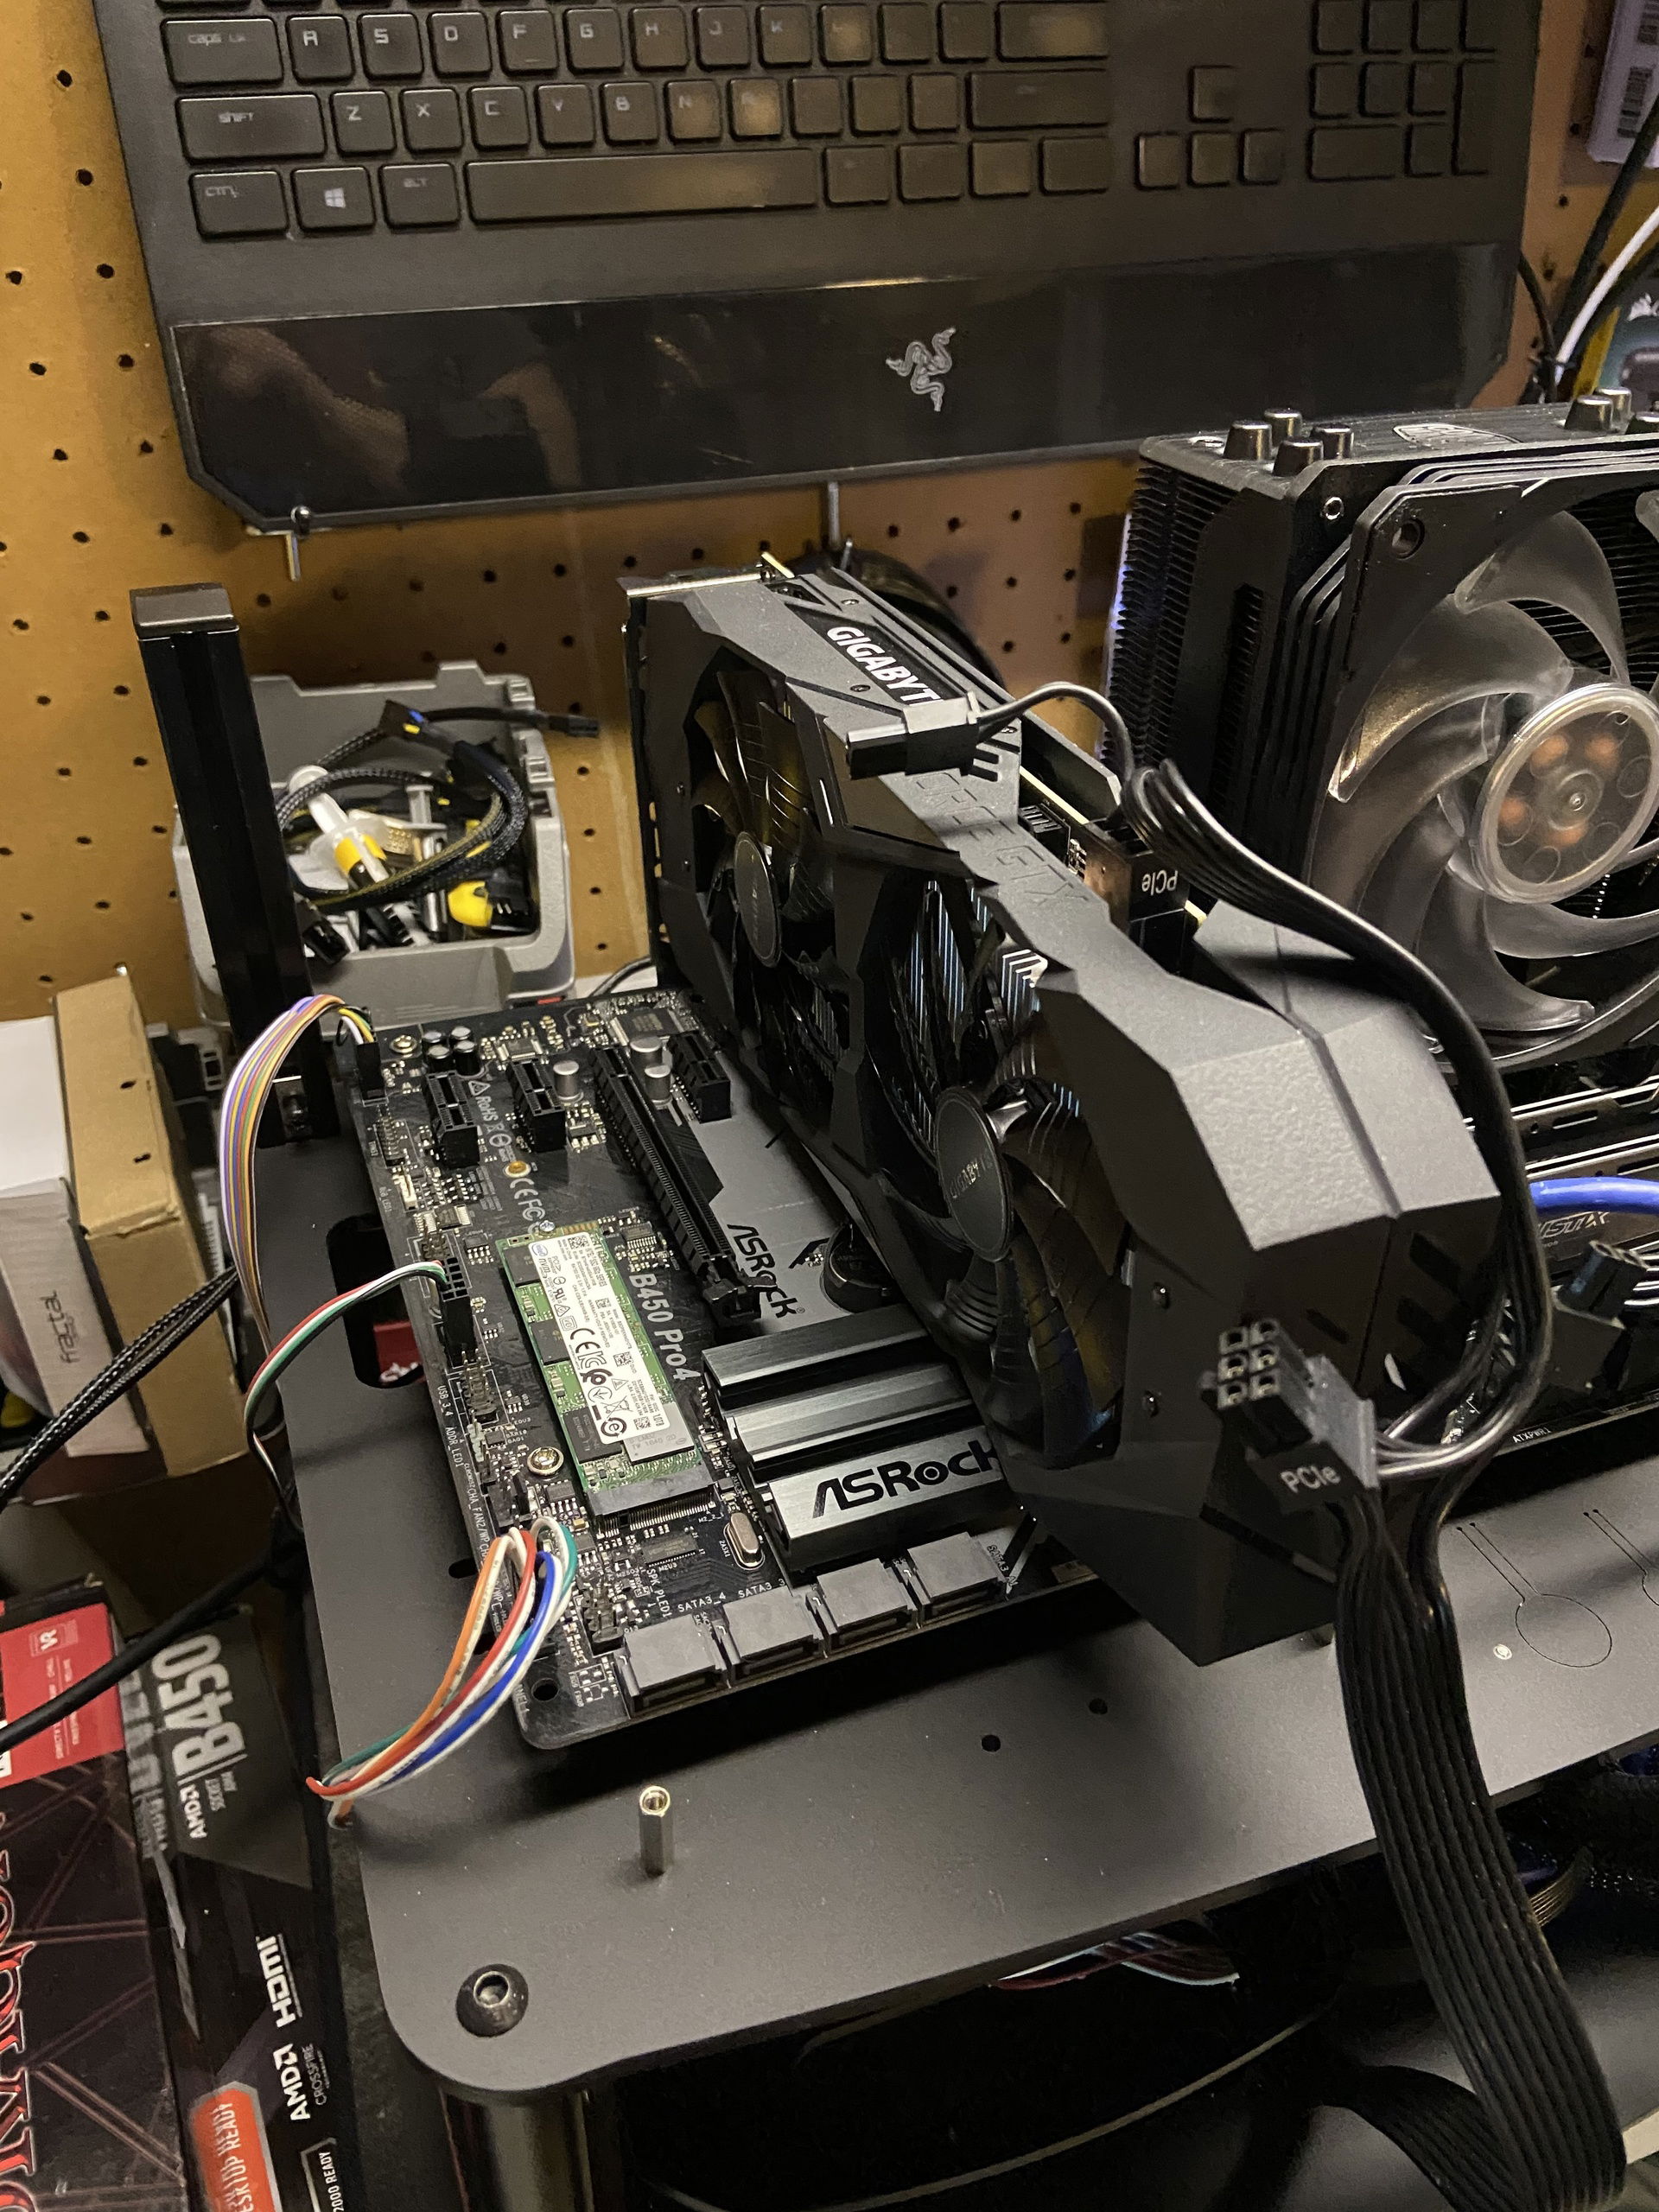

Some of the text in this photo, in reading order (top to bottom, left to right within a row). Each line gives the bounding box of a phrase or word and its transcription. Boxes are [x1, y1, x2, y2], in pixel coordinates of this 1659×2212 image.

[303, 30, 318, 46] A
[374, 29, 389, 43] S
[512, 24, 526, 39] F
[580, 23, 594, 38] G
[645, 22, 659, 35] H
[709, 22, 722, 35] J
[771, 21, 783, 34] K
[346, 105, 362, 121] Z
[416, 103, 430, 118] X
[485, 100, 499, 116] C
[827, 626, 944, 703] GIGABYT
[1141, 869, 1178, 897] PCIe
[40, 1290, 81, 1363] fractal
[630, 1273, 702, 1382] B450 Pro4
[811, 1439, 1000, 1519] ASRock
[1279, 1463, 1342, 1494] PCIe
[467, 1488, 491, 1544] CHA_FAN2/WP
[646, 1568, 672, 1618] SPK_PLED1
[677, 1592, 727, 1613] SATA3_4
[151, 1633, 247, 1777] B450
[179, 1788, 207, 1840] AMD
[257, 1936, 297, 2029] HDMI
[274, 2050, 311, 2122] AMD
[318, 2150, 338, 2187] READY
